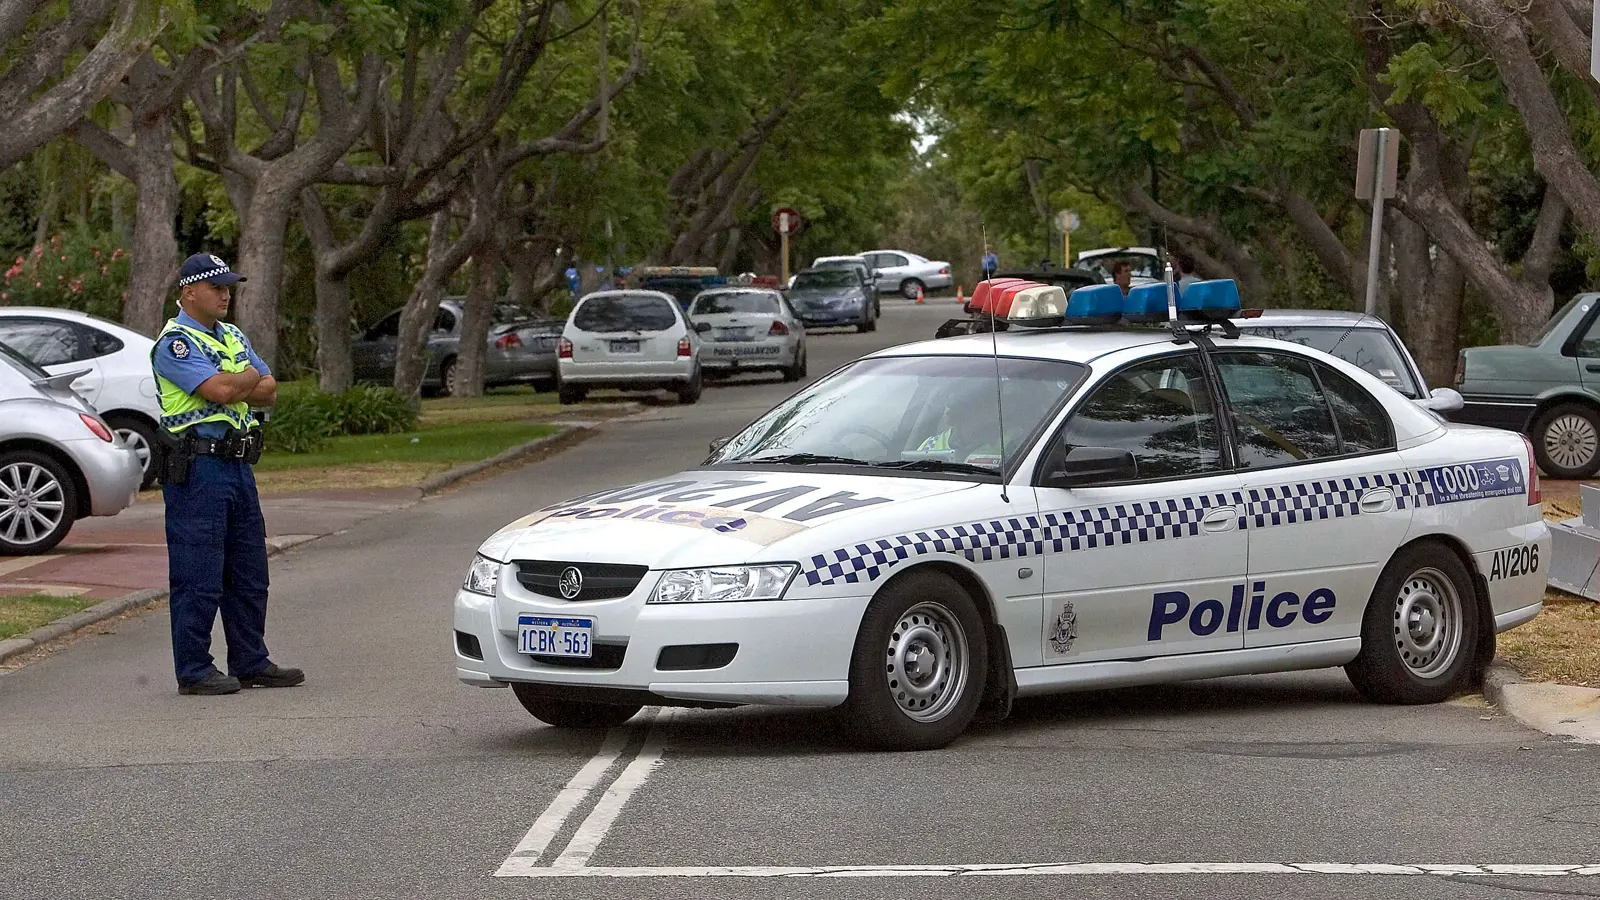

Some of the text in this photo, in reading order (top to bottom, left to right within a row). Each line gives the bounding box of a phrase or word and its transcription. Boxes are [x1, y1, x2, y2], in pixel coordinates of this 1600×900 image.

[1441, 464, 1480, 494] 000
[1460, 490, 1485, 500] threatening
[1485, 488, 1507, 497] emergency
[1490, 543, 1539, 581] AV206
[1147, 580, 1337, 642] Police
